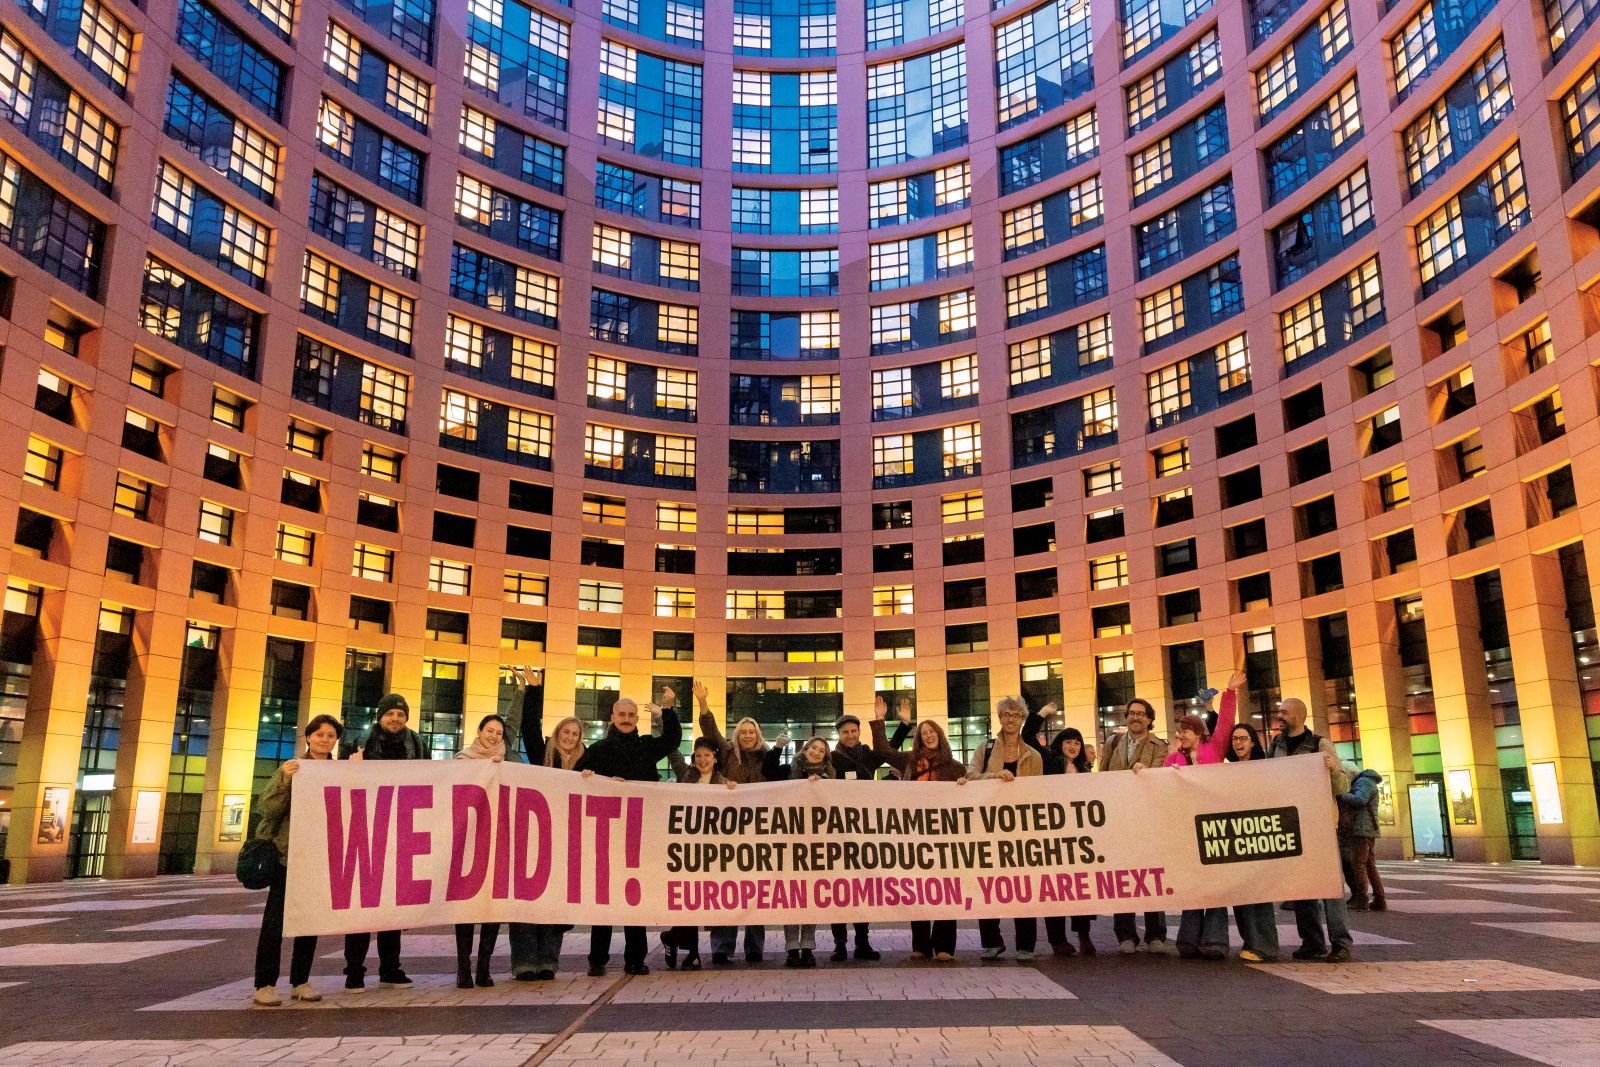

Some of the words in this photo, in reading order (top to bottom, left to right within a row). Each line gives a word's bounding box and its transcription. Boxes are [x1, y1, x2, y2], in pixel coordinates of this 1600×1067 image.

[668, 805, 805, 835] EUROPEAN
[811, 806, 974, 835] PARLIAMENT
[979, 802, 1066, 833] VOTED
[1070, 800, 1106, 828] TO
[1202, 819, 1227, 838] MY
[1231, 815, 1282, 836] VOICE
[324, 785, 433, 910] WE
[446, 784, 551, 901] DID
[567, 793, 643, 906] IT!
[667, 842, 787, 872] SUPPORT
[792, 840, 993, 871] REPRODUCTIVE
[997, 836, 1105, 868] RIGHTS.
[1205, 839, 1229, 858] MY
[1234, 833, 1296, 855] CHOICE
[667, 879, 807, 910] EUROPEAN
[813, 876, 973, 910] COMISSION,
[977, 875, 1032, 904] YOU
[1039, 872, 1091, 902] ARE
[1096, 867, 1174, 900] NEXT.
